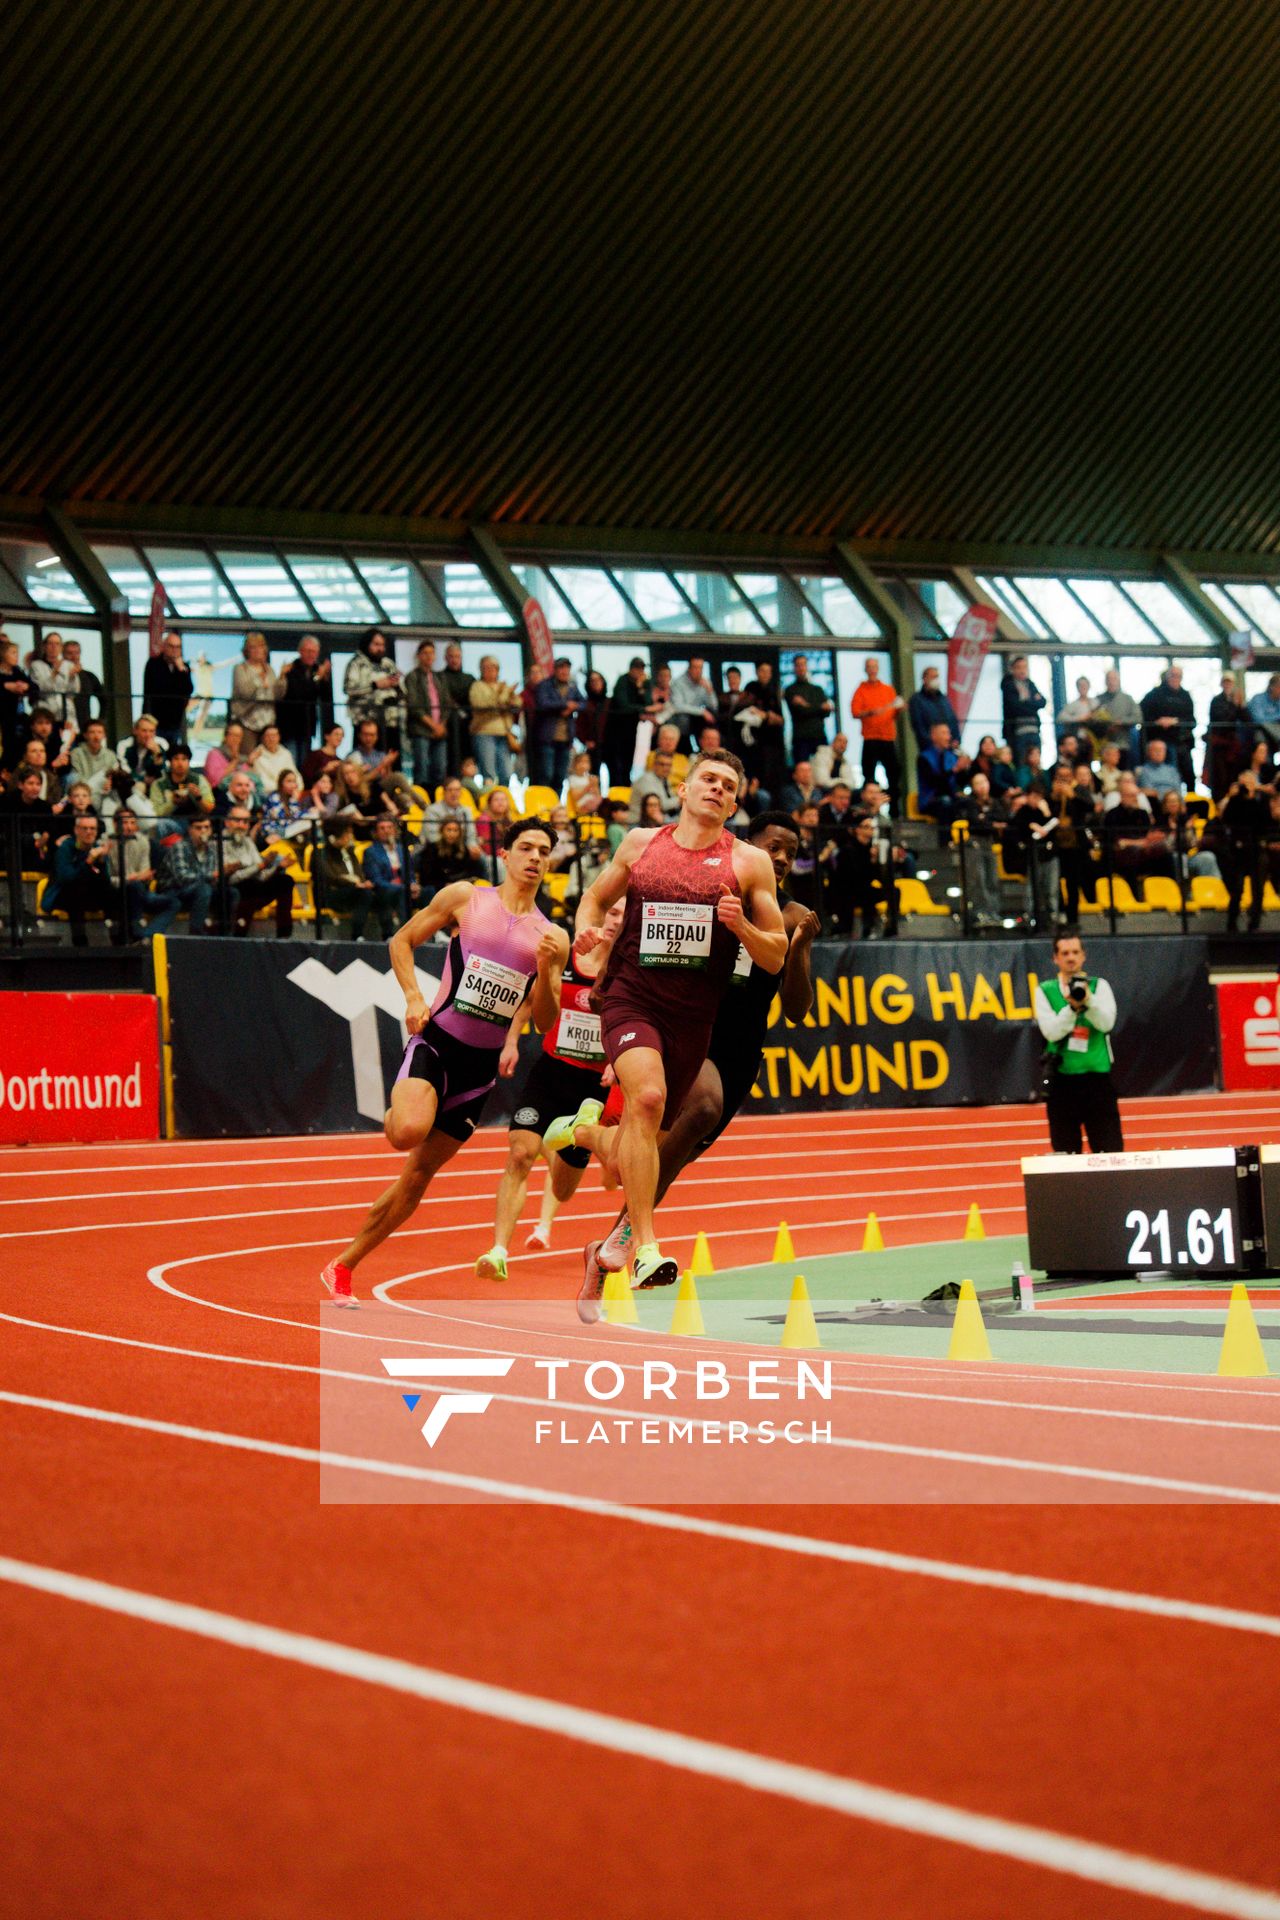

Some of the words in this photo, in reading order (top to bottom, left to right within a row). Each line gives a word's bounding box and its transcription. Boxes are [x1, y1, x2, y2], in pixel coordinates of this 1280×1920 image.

[646, 923, 706, 942] BREDAU
[666, 941, 682, 954] 22
[644, 956, 679, 964] DORTMUND
[465, 974, 519, 1006] SACOOR
[478, 995, 497, 1011] 159
[567, 1026, 601, 1042] KROLL
[575, 1040, 591, 1052] 103
[750, 1040, 949, 1098] TMUND
[1125, 1208, 1235, 1264] 21.61
